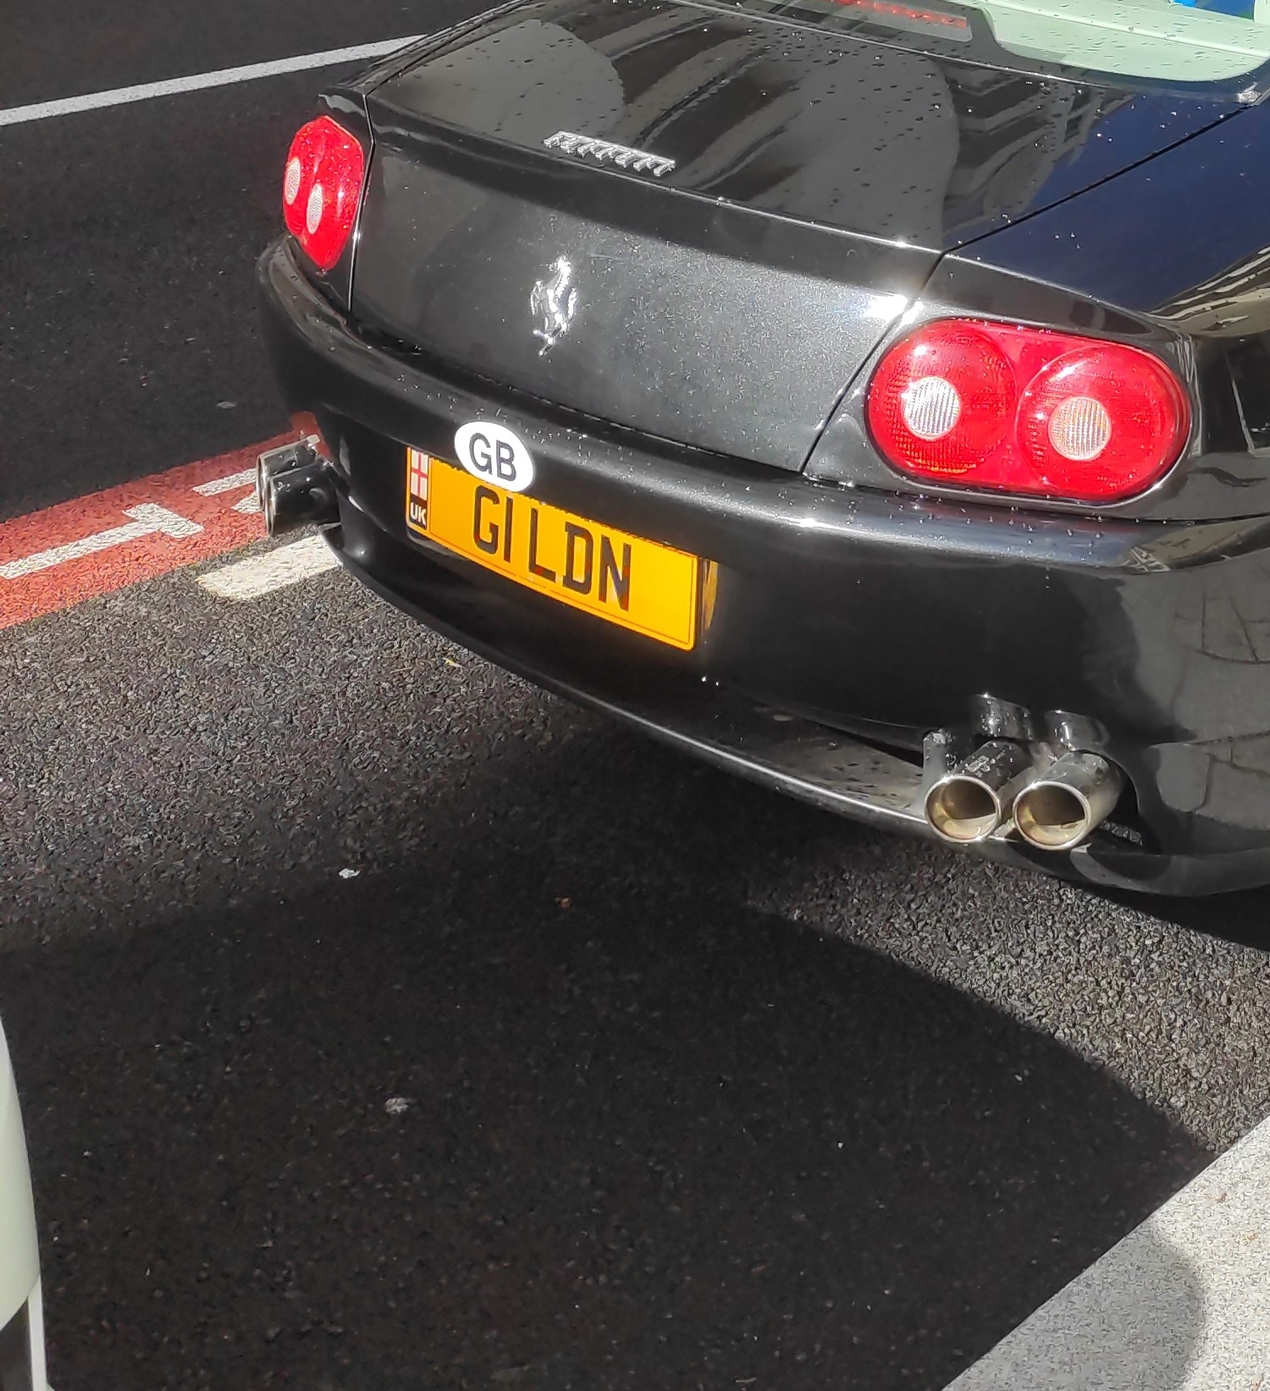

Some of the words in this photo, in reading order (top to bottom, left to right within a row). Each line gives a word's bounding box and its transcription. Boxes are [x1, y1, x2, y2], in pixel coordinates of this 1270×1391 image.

[469, 432, 517, 482] GB
[409, 501, 427, 527] UK
[528, 506, 632, 613] LDN
